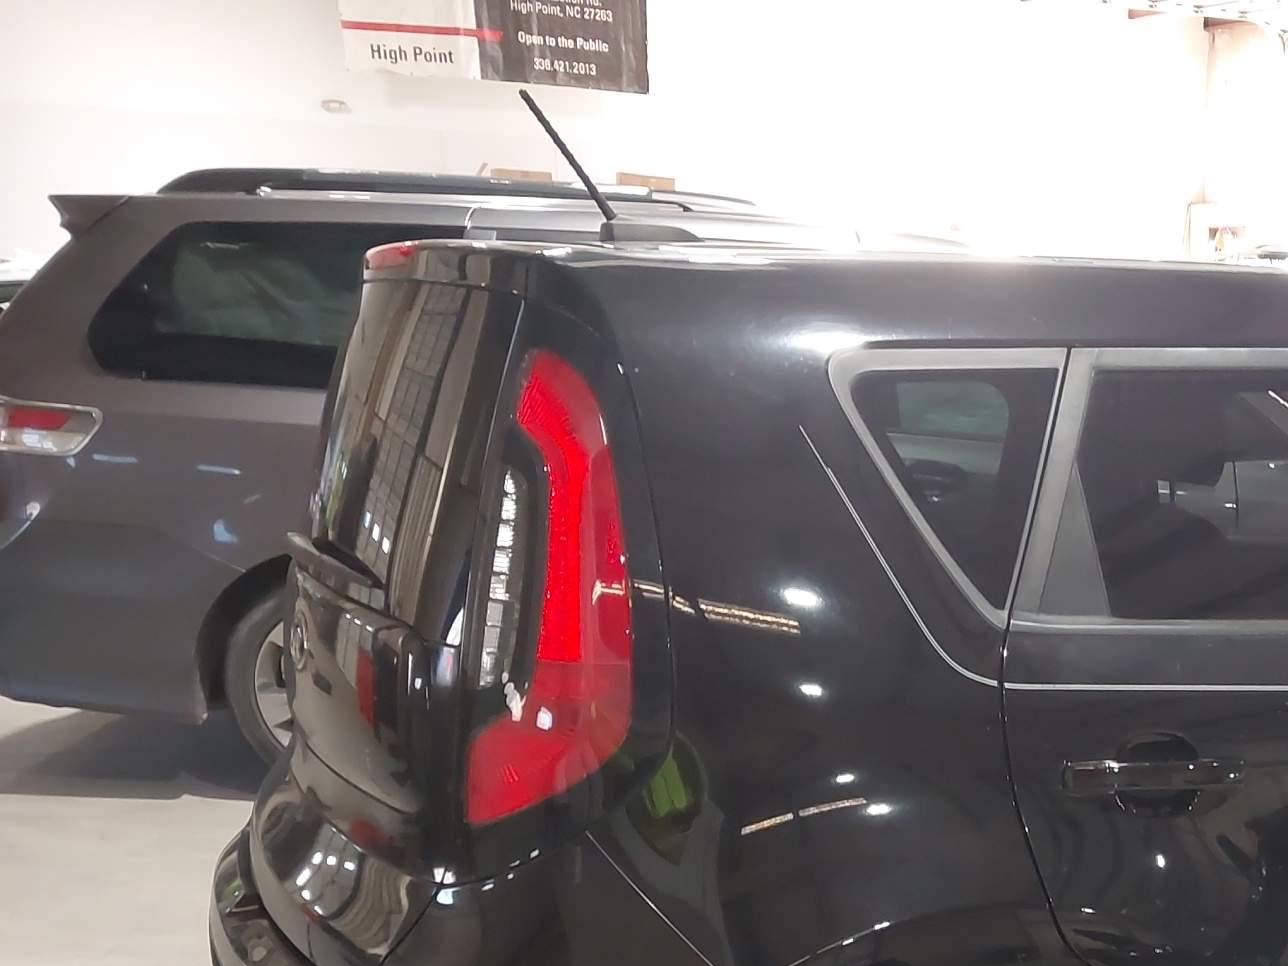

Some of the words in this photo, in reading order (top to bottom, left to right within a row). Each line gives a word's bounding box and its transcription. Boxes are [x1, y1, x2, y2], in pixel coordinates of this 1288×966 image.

[510, 0, 534, 14] High
[535, 2, 563, 17] Point,
[566, 6, 581, 18] NC
[583, 7, 613, 22] 27263
[518, 31, 543, 45] Open
[545, 35, 555, 47] to
[557, 36, 574, 49] the
[576, 38, 609, 52] Public
[370, 43, 408, 64] High
[413, 46, 454, 64] Point
